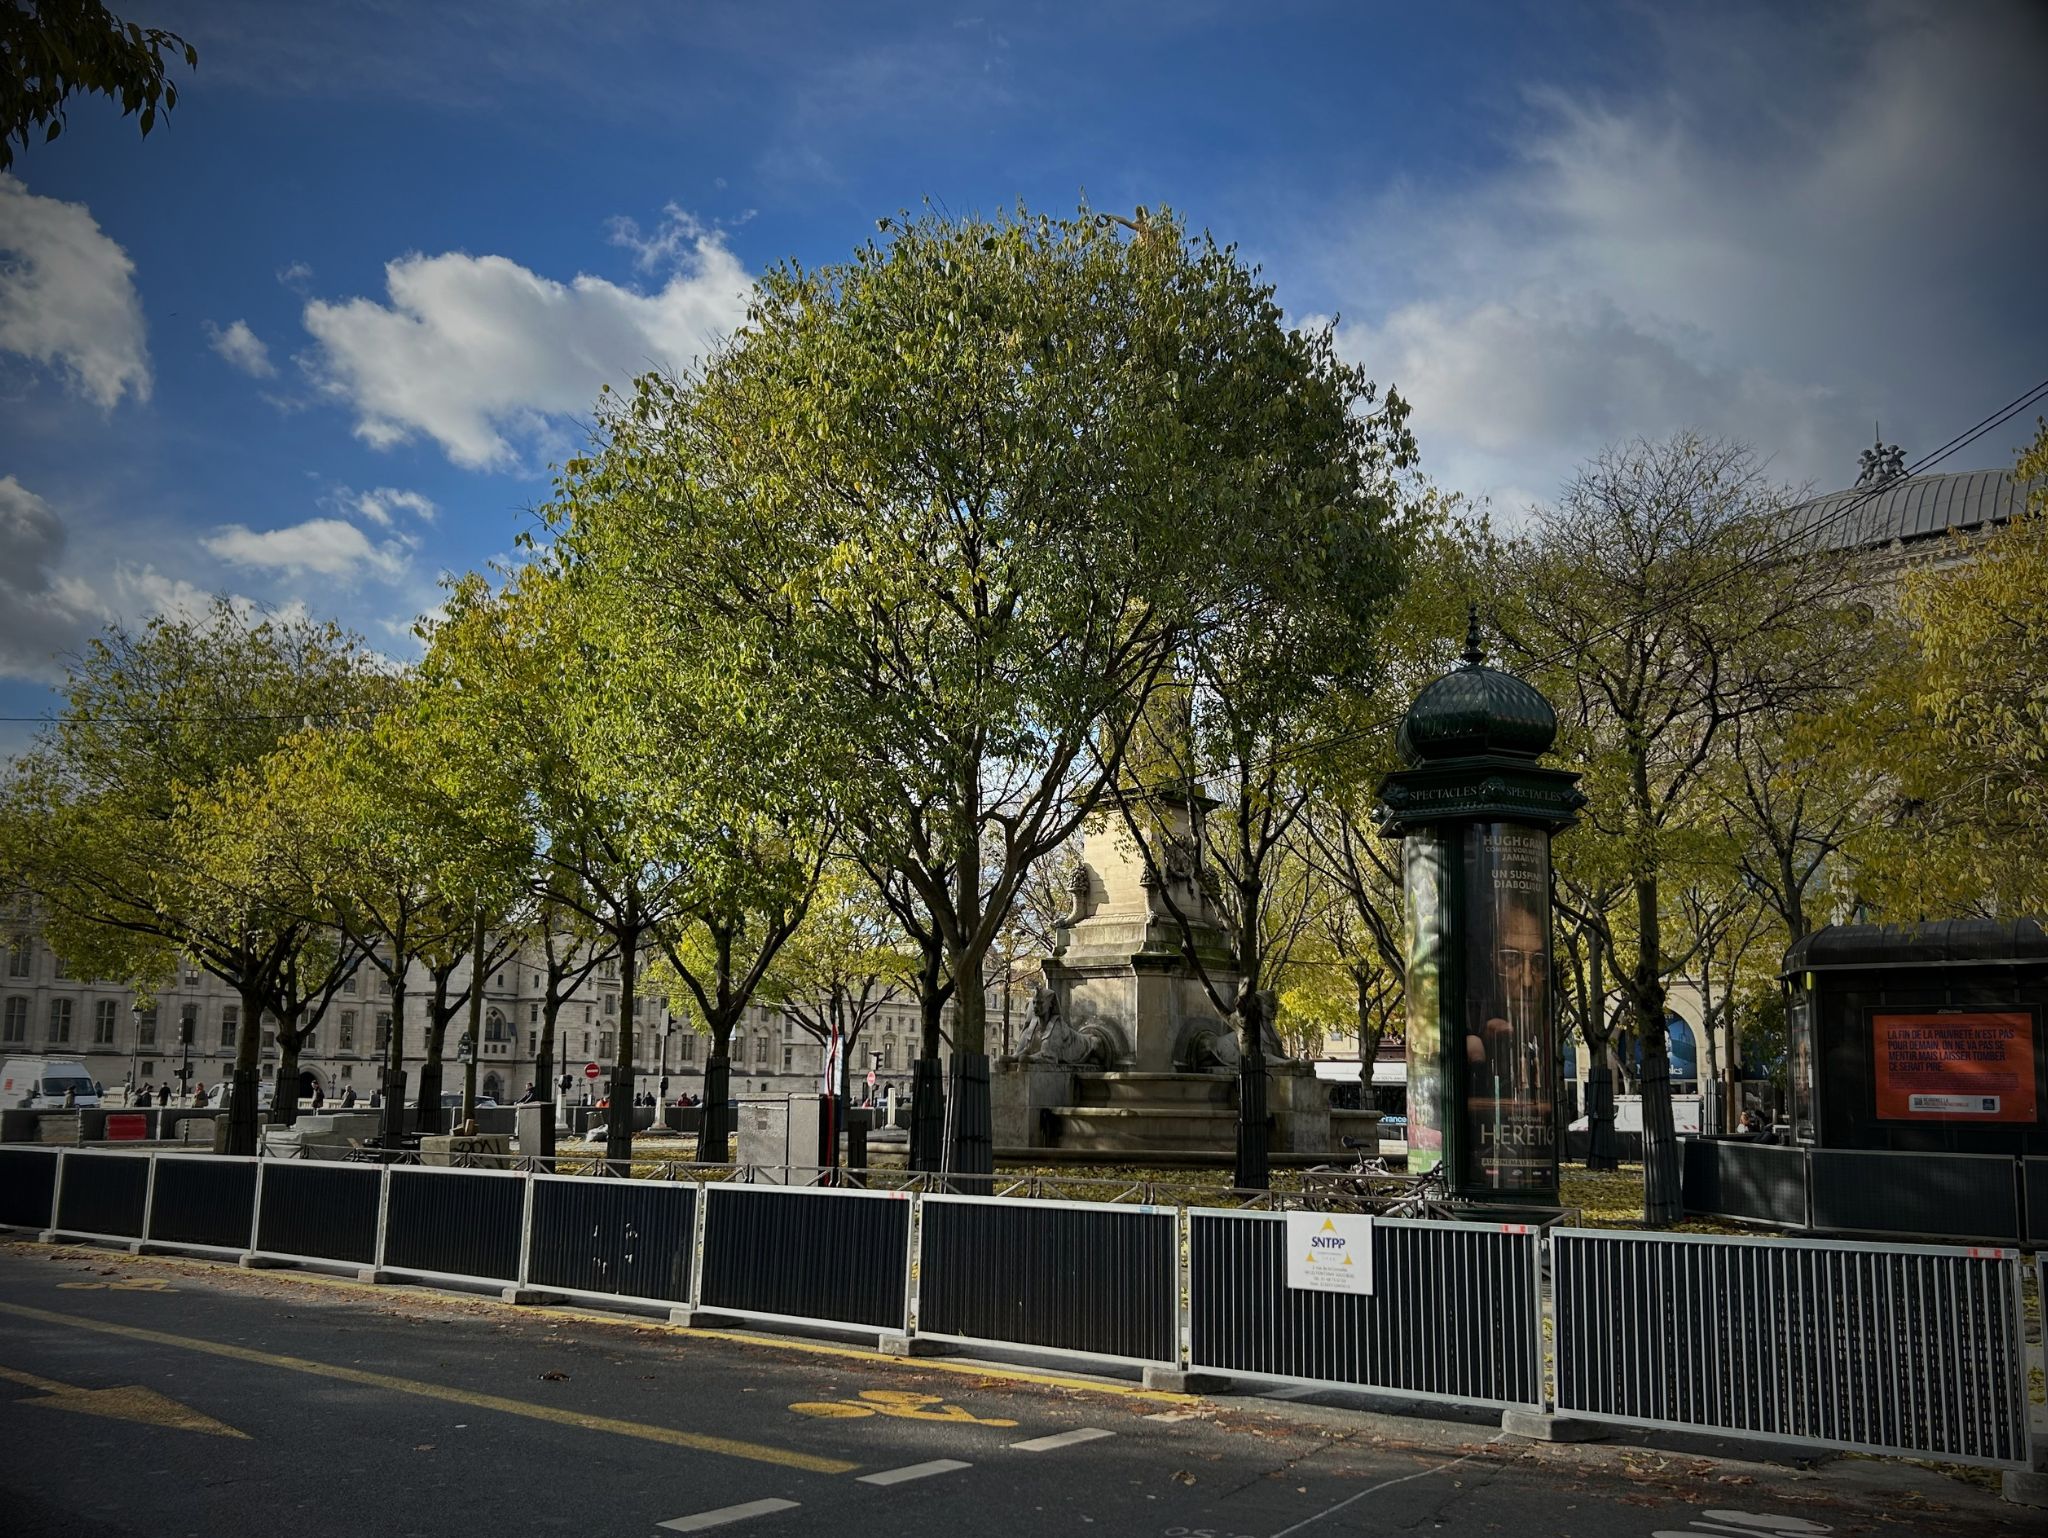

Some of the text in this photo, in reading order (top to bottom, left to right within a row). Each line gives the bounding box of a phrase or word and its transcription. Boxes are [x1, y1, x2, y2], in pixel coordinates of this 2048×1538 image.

[1409, 785, 1477, 801] SPECTACLES
[1506, 785, 1562, 802] SPECTACLES
[1483, 835, 1521, 847] HUGH
[1491, 869, 1508, 879] UN
[1888, 1040, 1908, 1050] POUR
[1939, 1051, 1971, 1061] LAISSER
[1899, 1061, 1925, 1072] SERAIT
[1311, 1236, 1346, 1249] SNTPP
